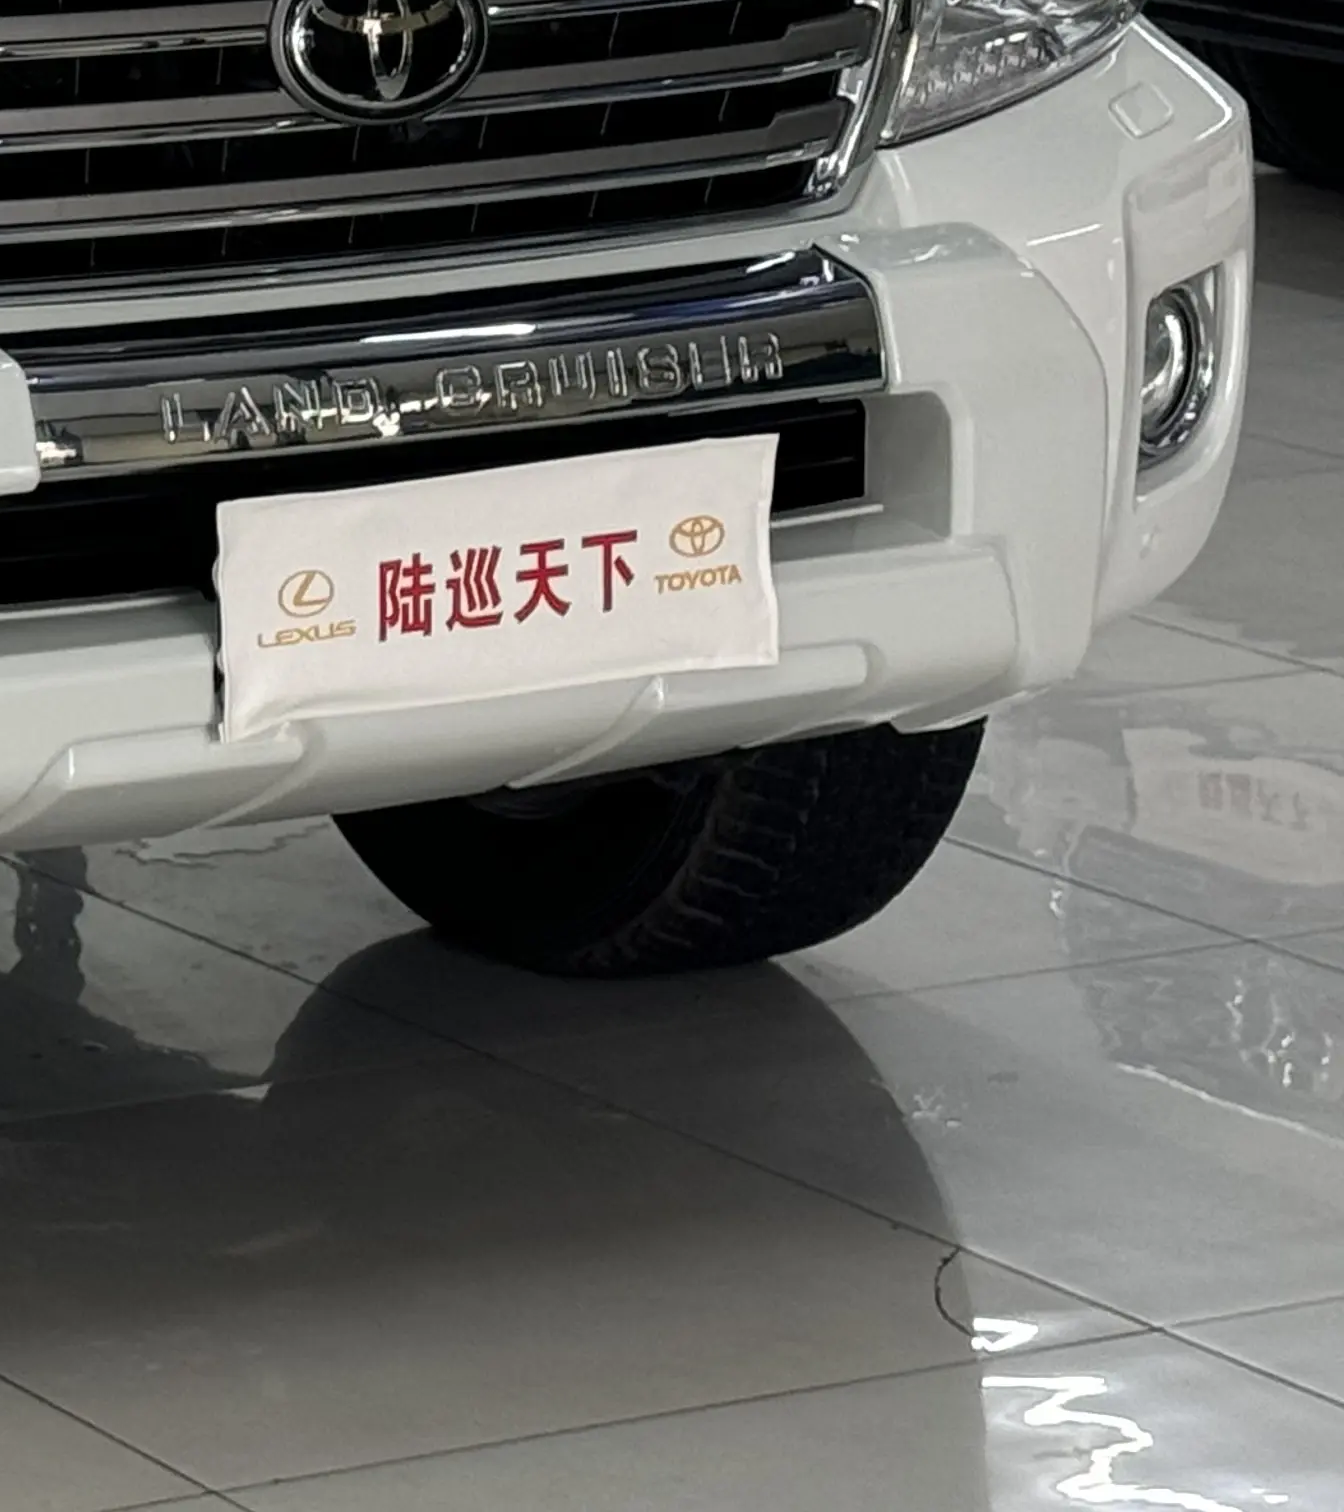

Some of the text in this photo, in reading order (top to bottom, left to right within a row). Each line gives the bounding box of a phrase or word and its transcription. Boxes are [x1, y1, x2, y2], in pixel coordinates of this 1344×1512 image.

[161, 376, 383, 443] LAND
[377, 529, 639, 642] 陆巡天下
[654, 563, 743, 595] TOYOTA
[256, 619, 358, 649] LEXUS
